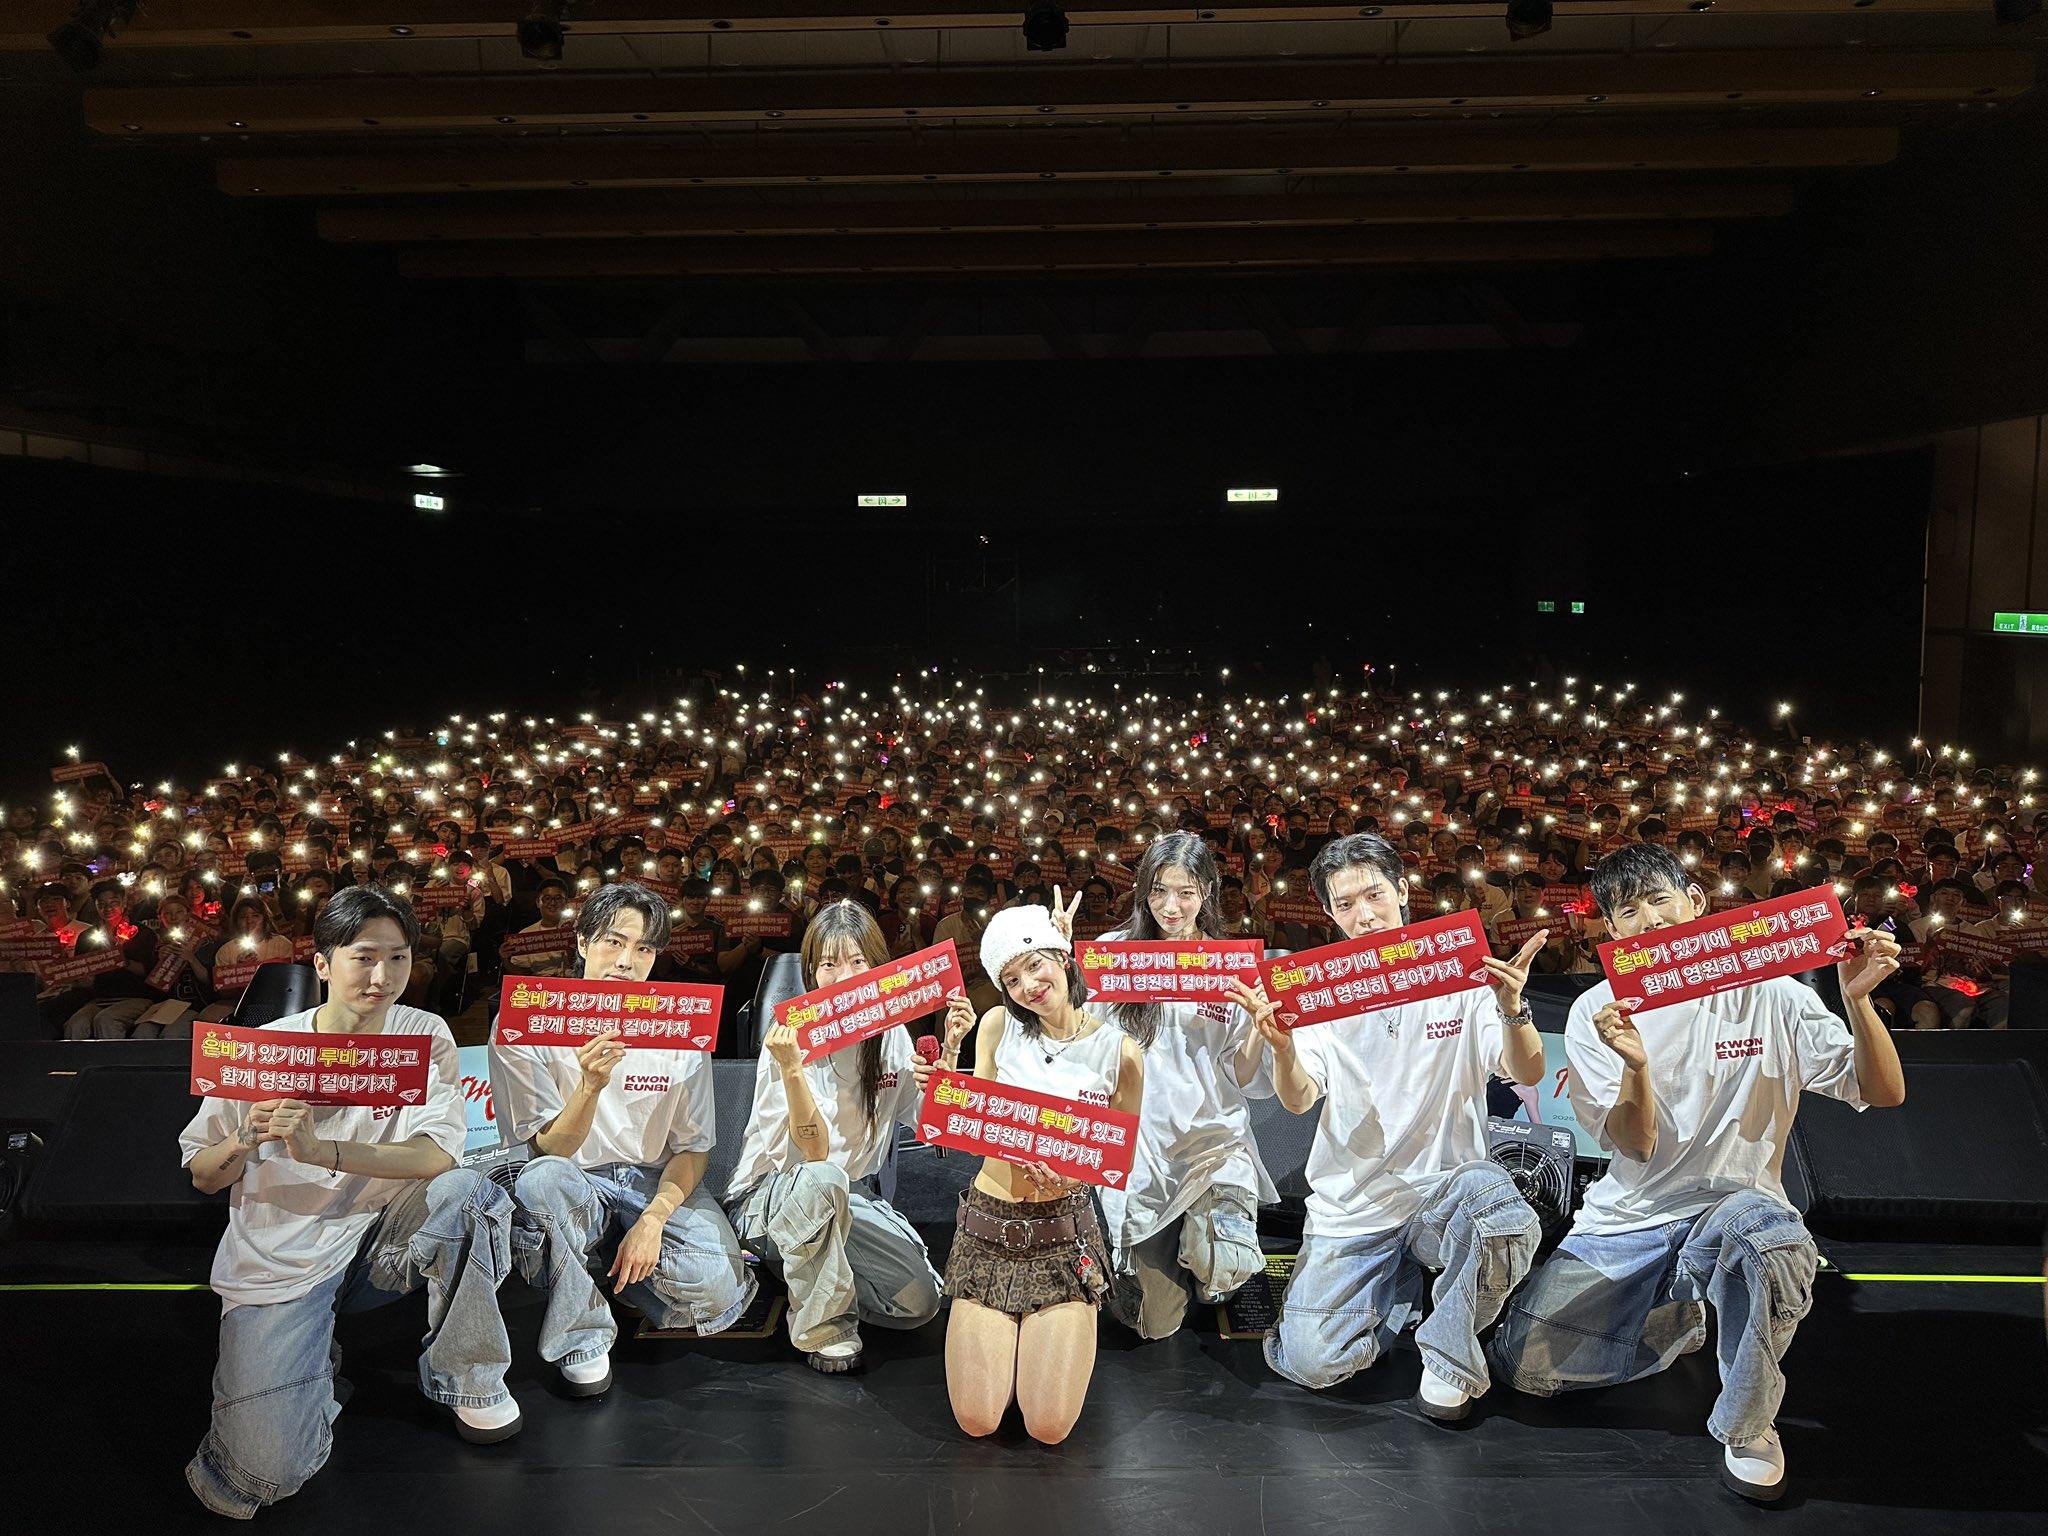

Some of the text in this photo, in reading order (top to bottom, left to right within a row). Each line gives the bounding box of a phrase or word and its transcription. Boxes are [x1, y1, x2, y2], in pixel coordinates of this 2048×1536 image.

[1611, 901, 1832, 975] 은비가 있기에 루비가 있고
[1082, 951, 1257, 970] 은비가 있기에 루비가 있고
[1270, 964, 1324, 992] 은비가
[1322, 948, 1380, 978] 있기에
[1379, 935, 1434, 965] 루비가
[1435, 926, 1476, 953] 있고
[1640, 970, 1683, 996] 함께
[1682, 953, 1742, 984] 영원히
[1741, 933, 1820, 970] 걸어가자
[786, 1001, 833, 1029] 은비가
[832, 982, 879, 1013] 있기에
[878, 965, 922, 994] 루비가
[921, 953, 952, 979] 있고
[1100, 974, 1130, 991] 함께
[1132, 974, 1178, 991] 영원히
[1296, 989, 1334, 1013] 함께
[1334, 976, 1389, 1003] 영원히
[1390, 958, 1463, 992] 걸어가자
[510, 989, 712, 1015] 은비가 있기에 루비가 있고
[807, 1020, 841, 1046] 함께
[840, 1004, 885, 1035] 영원히
[885, 982, 943, 1016] 걸어가자
[1196, 1001, 1233, 1016] KWON
[528, 1014, 691, 1038] 함께 영원히 걸어가자
[1196, 1008, 1231, 1024] EUNBI
[1427, 1026, 1462, 1040] EUNB
[1714, 1037, 1764, 1051] KWON
[201, 1038, 419, 1068] 은비가 있기에 루비가 있고
[1717, 1046, 1764, 1060] EUNBI
[220, 1066, 397, 1093] 함께 영원히 걸어가자
[623, 1084, 669, 1092] EUNBI
[625, 1075, 670, 1084] KWON
[934, 1084, 1127, 1146] 은비가 있기에 루비가 있고
[946, 1113, 983, 1140] 함께
[983, 1122, 1035, 1151] 영원히
[1035, 1134, 1103, 1170] 걸어가자
